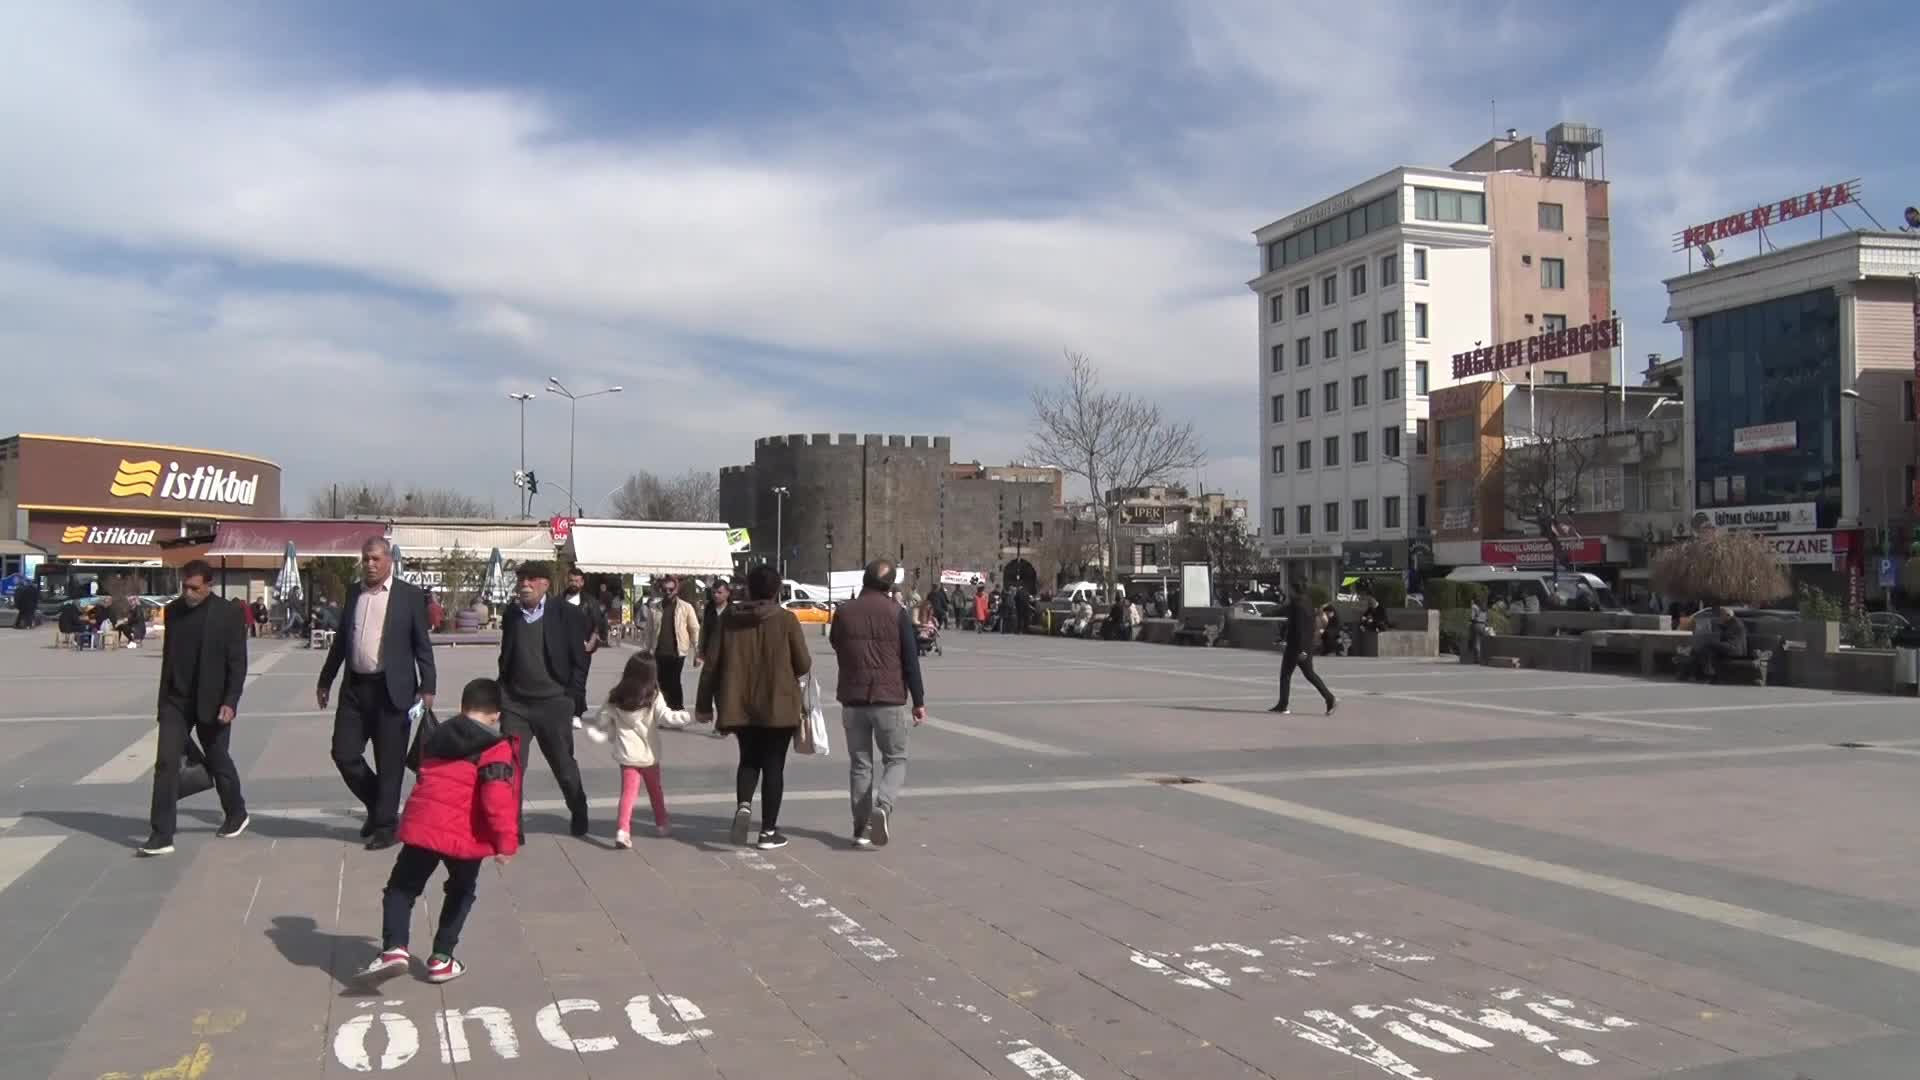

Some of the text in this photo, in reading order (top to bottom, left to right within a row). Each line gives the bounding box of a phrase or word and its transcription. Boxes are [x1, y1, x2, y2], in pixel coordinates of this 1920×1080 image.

[1780, 183, 1848, 222] PLAZA
[1453, 340, 1522, 379] DAĞKAPI
[160, 461, 259, 505] istikbal
[87, 526, 155, 545] istikbal
[1715, 509, 1791, 526] İŞİTME CİHAZLARI
[1881, 559, 1891, 574] P
[333, 994, 713, 1072] önce
